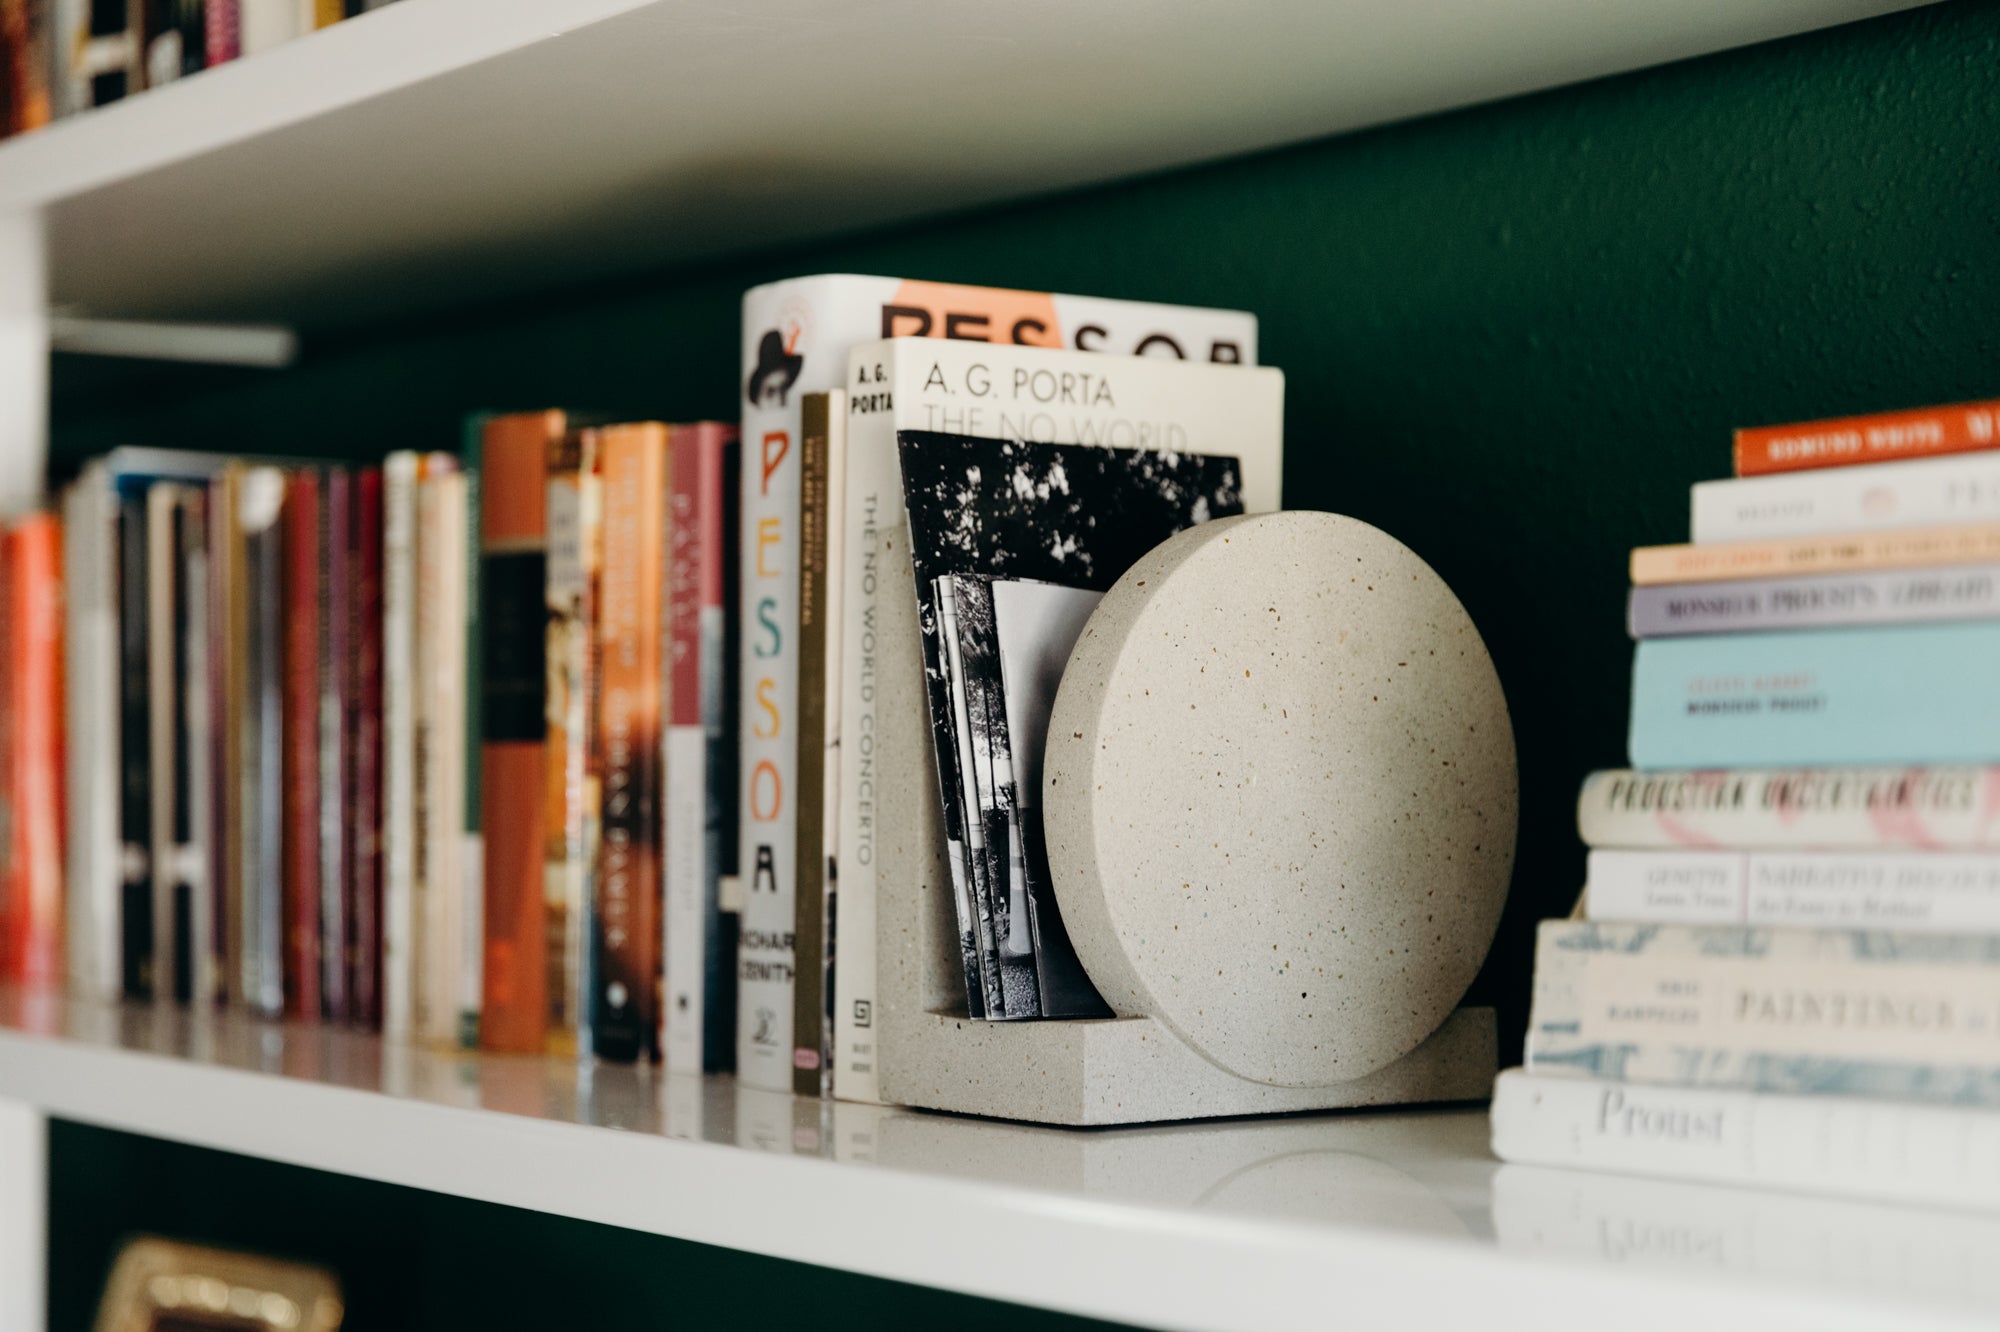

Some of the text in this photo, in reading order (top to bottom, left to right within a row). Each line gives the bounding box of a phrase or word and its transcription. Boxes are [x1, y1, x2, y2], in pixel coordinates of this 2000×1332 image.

[858, 364, 887, 383] A. G.
[923, 361, 1116, 408] A. G. PORTA
[851, 393, 893, 415] PORTA
[922, 403, 1189, 450] THE NO WORLD
[1767, 430, 1863, 462] EDMUND
[1864, 418, 1944, 451] WHITE
[750, 431, 790, 893] PESSOA
[857, 494, 877, 866] THE NO WORLD CONCERTO
[1609, 776, 1974, 812] PROUSTIAN UNCERTAINTIES
[1597, 1087, 1724, 1144] Proust
